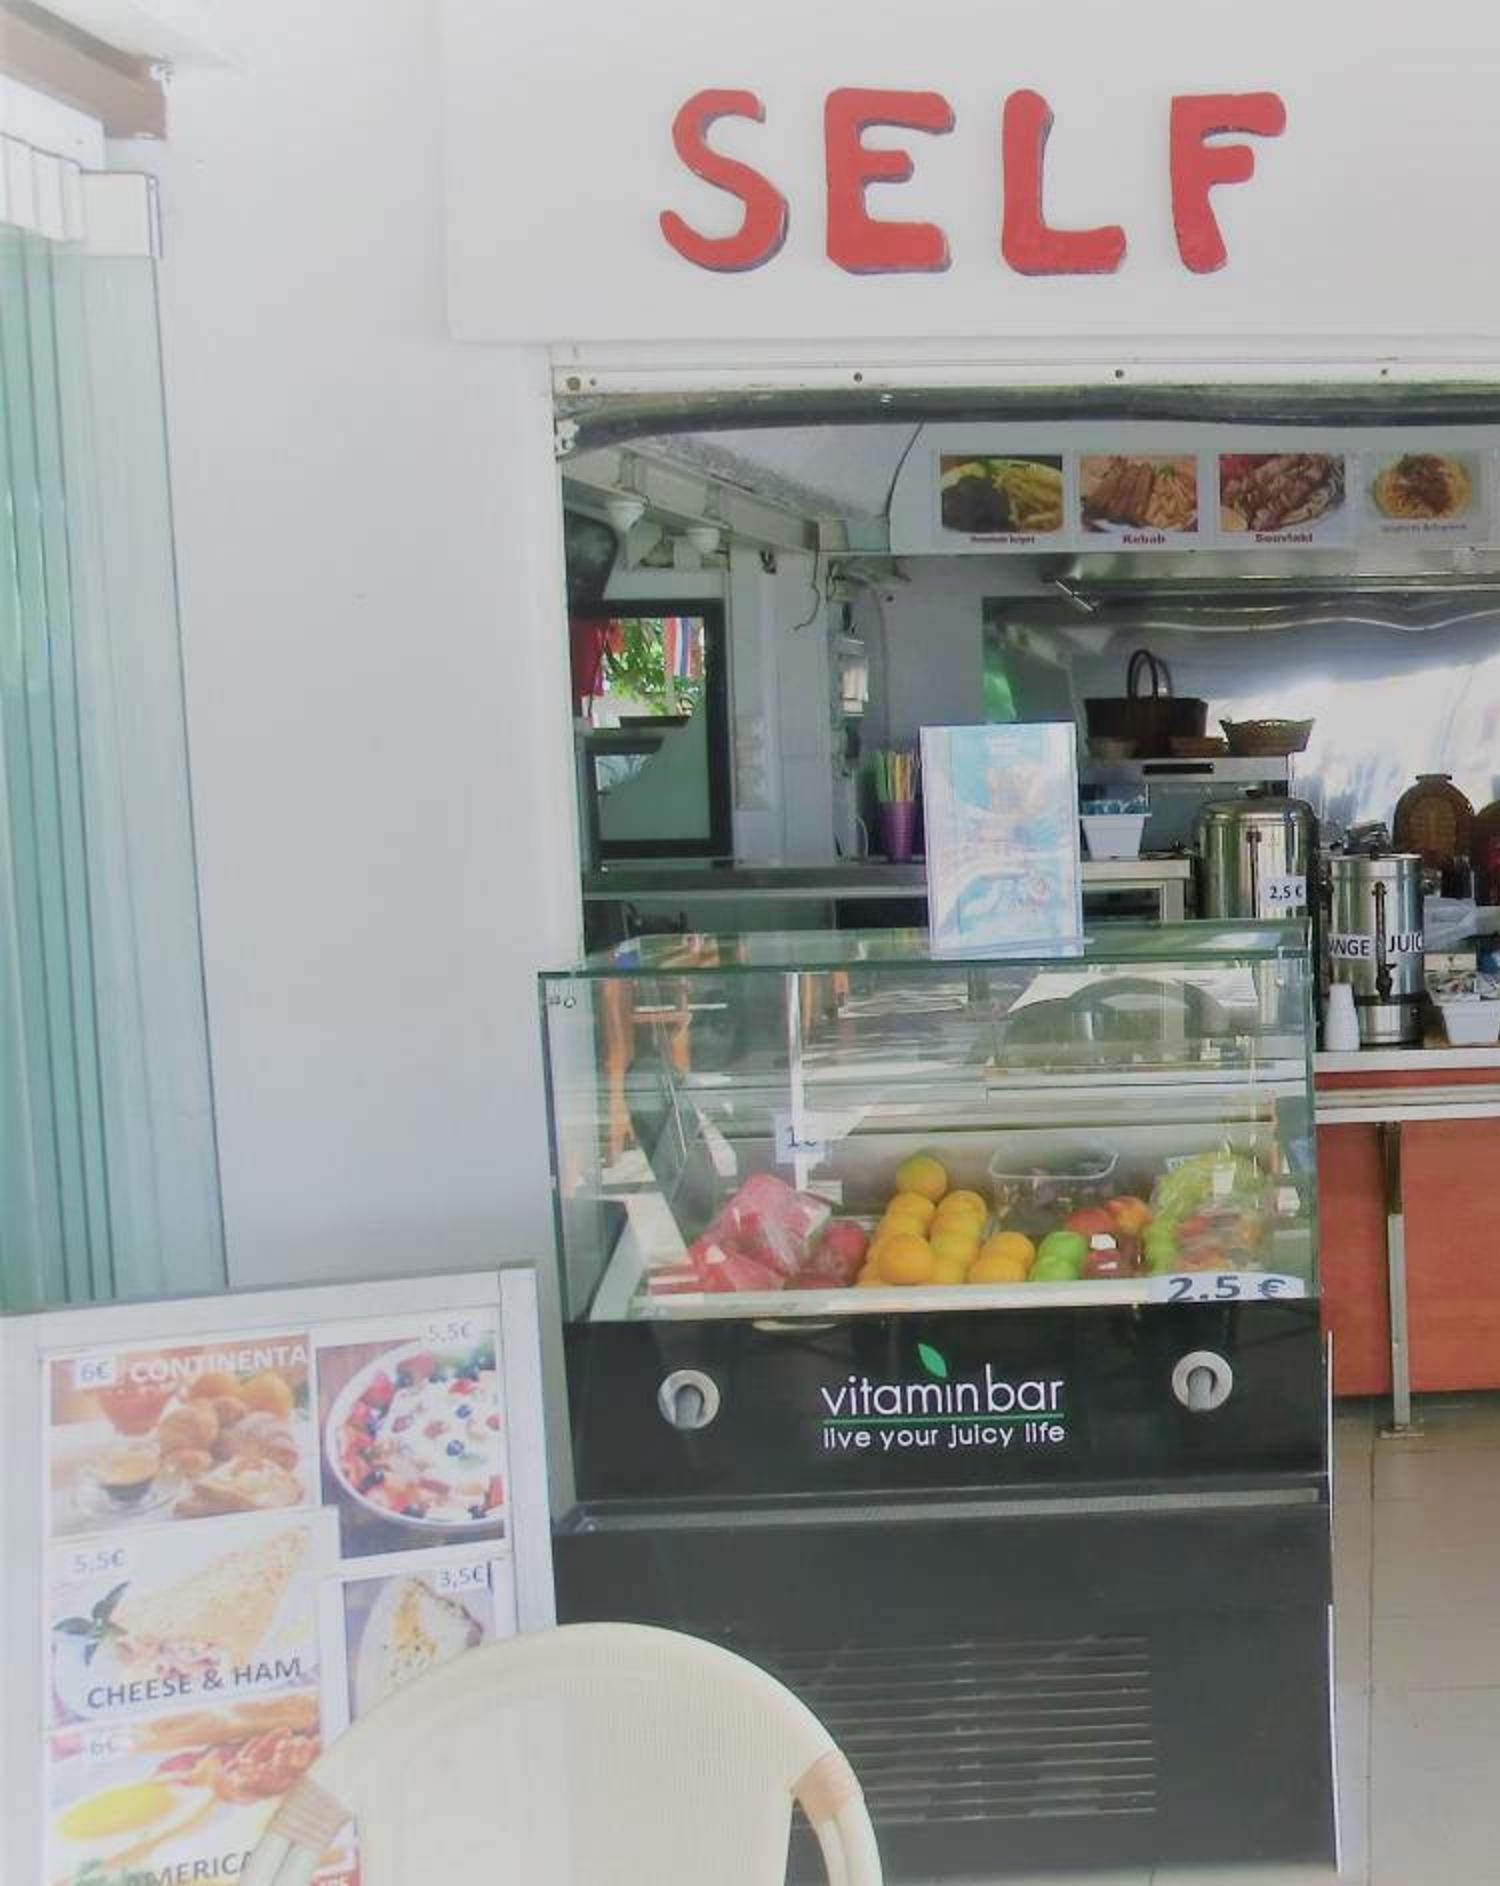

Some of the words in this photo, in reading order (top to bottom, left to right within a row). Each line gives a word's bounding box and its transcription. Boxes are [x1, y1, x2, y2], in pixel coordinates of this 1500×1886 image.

[658, 88, 1287, 276] SELF
[823, 1427, 871, 1449] live
[880, 1428, 939, 1451] your
[948, 1423, 1014, 1449] juicy
[1025, 1421, 1065, 1443] life
[87, 1675, 192, 1709] CHEESE
[202, 1667, 224, 1691] &
[233, 1657, 302, 1686] HAM
